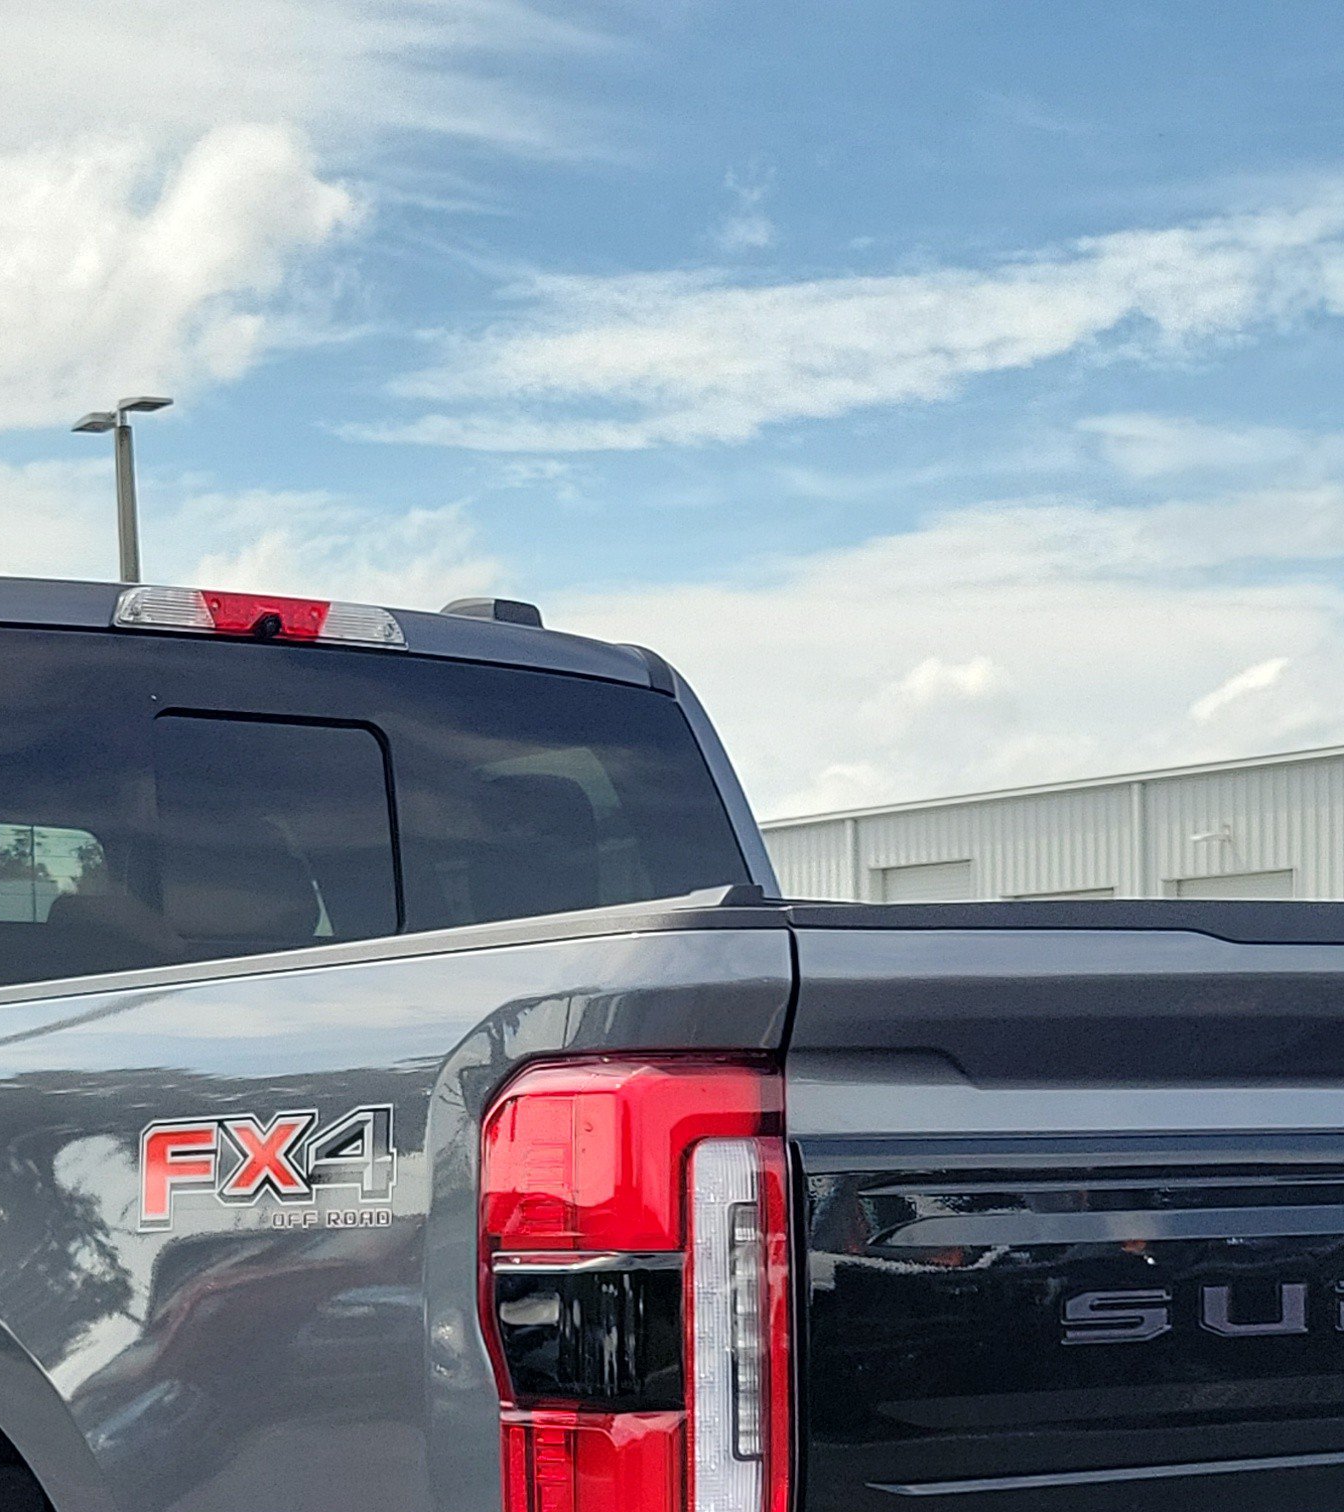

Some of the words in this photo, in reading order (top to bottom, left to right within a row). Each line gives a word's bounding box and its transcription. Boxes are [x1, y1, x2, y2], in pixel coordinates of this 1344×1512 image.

[138, 1103, 397, 1232] FX4
[271, 1211, 320, 1230] OFF
[326, 1208, 394, 1228] ROAD
